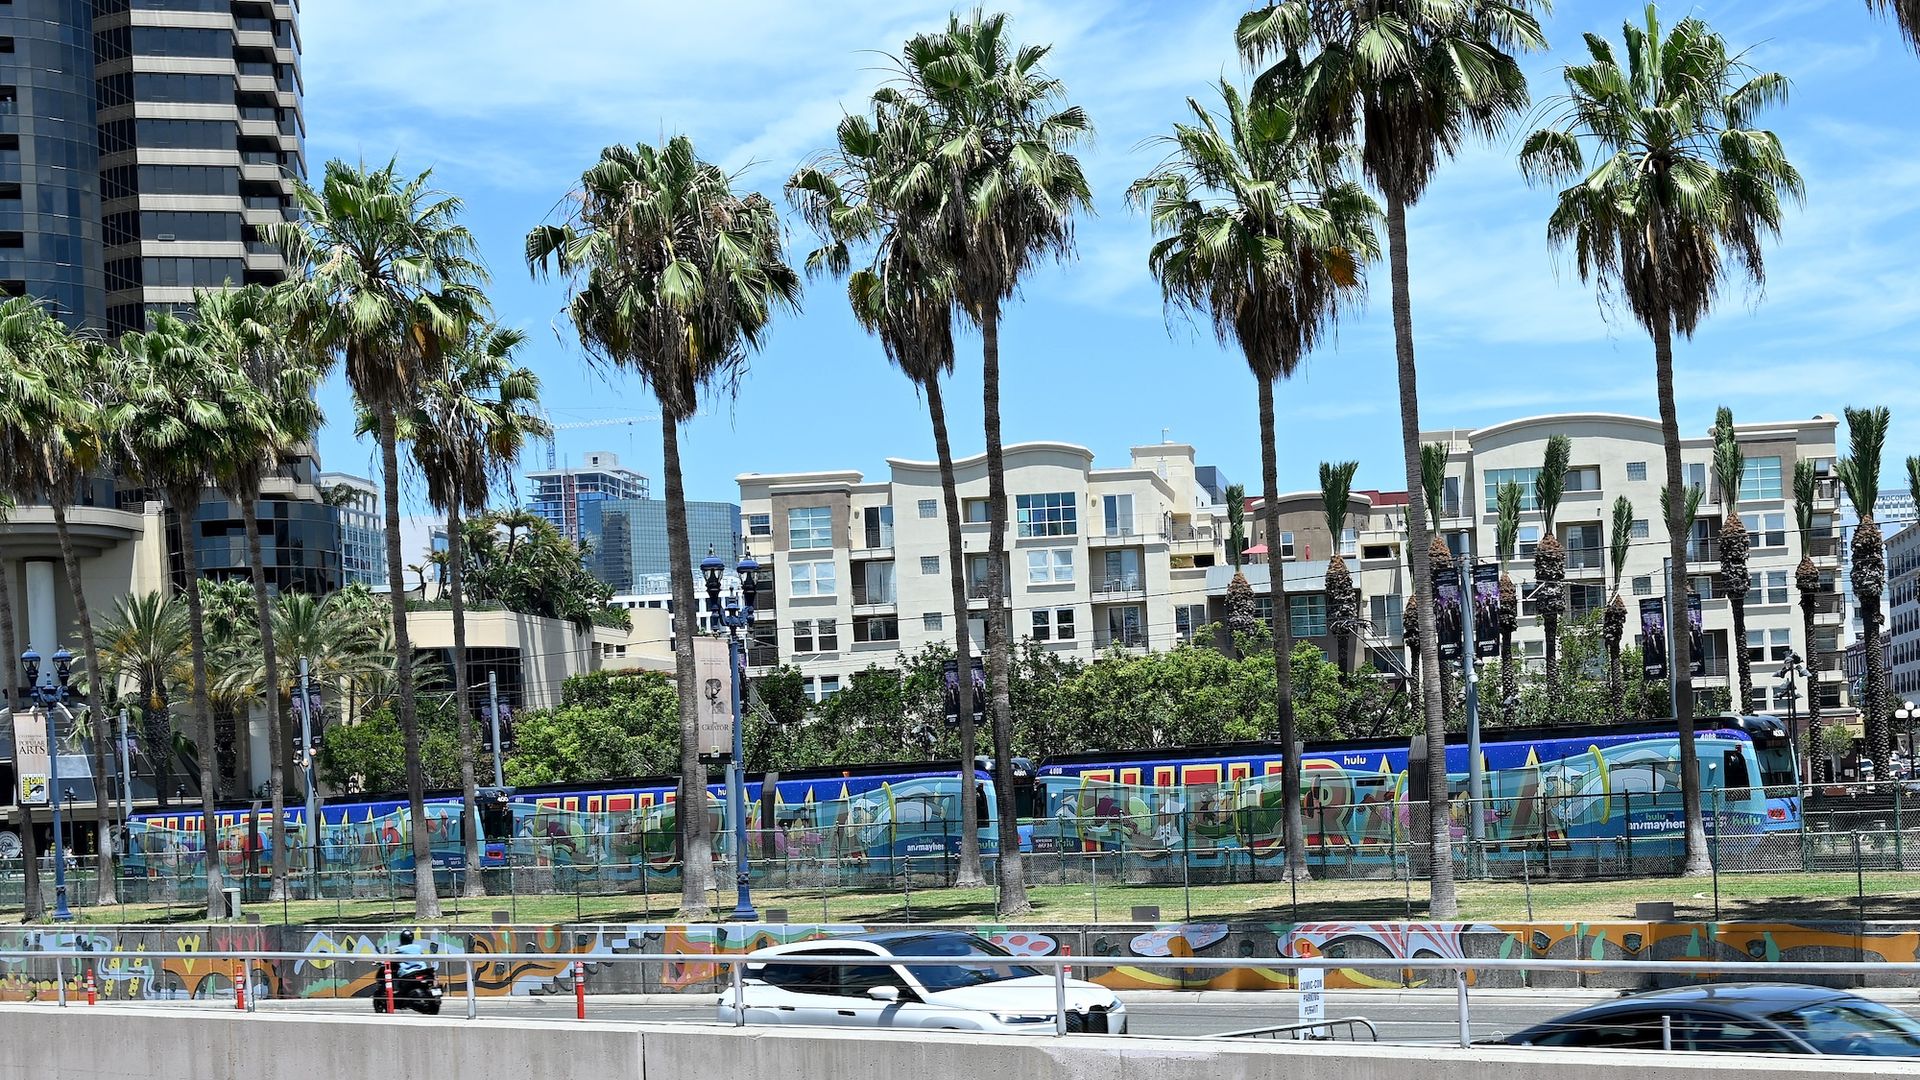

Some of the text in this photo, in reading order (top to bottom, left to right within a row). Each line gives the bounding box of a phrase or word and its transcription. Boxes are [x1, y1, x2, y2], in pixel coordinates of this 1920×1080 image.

[18, 745, 46, 755] ARTS
[1343, 754, 1367, 766] hulu
[1300, 979, 1323, 991] COMIC-CON
